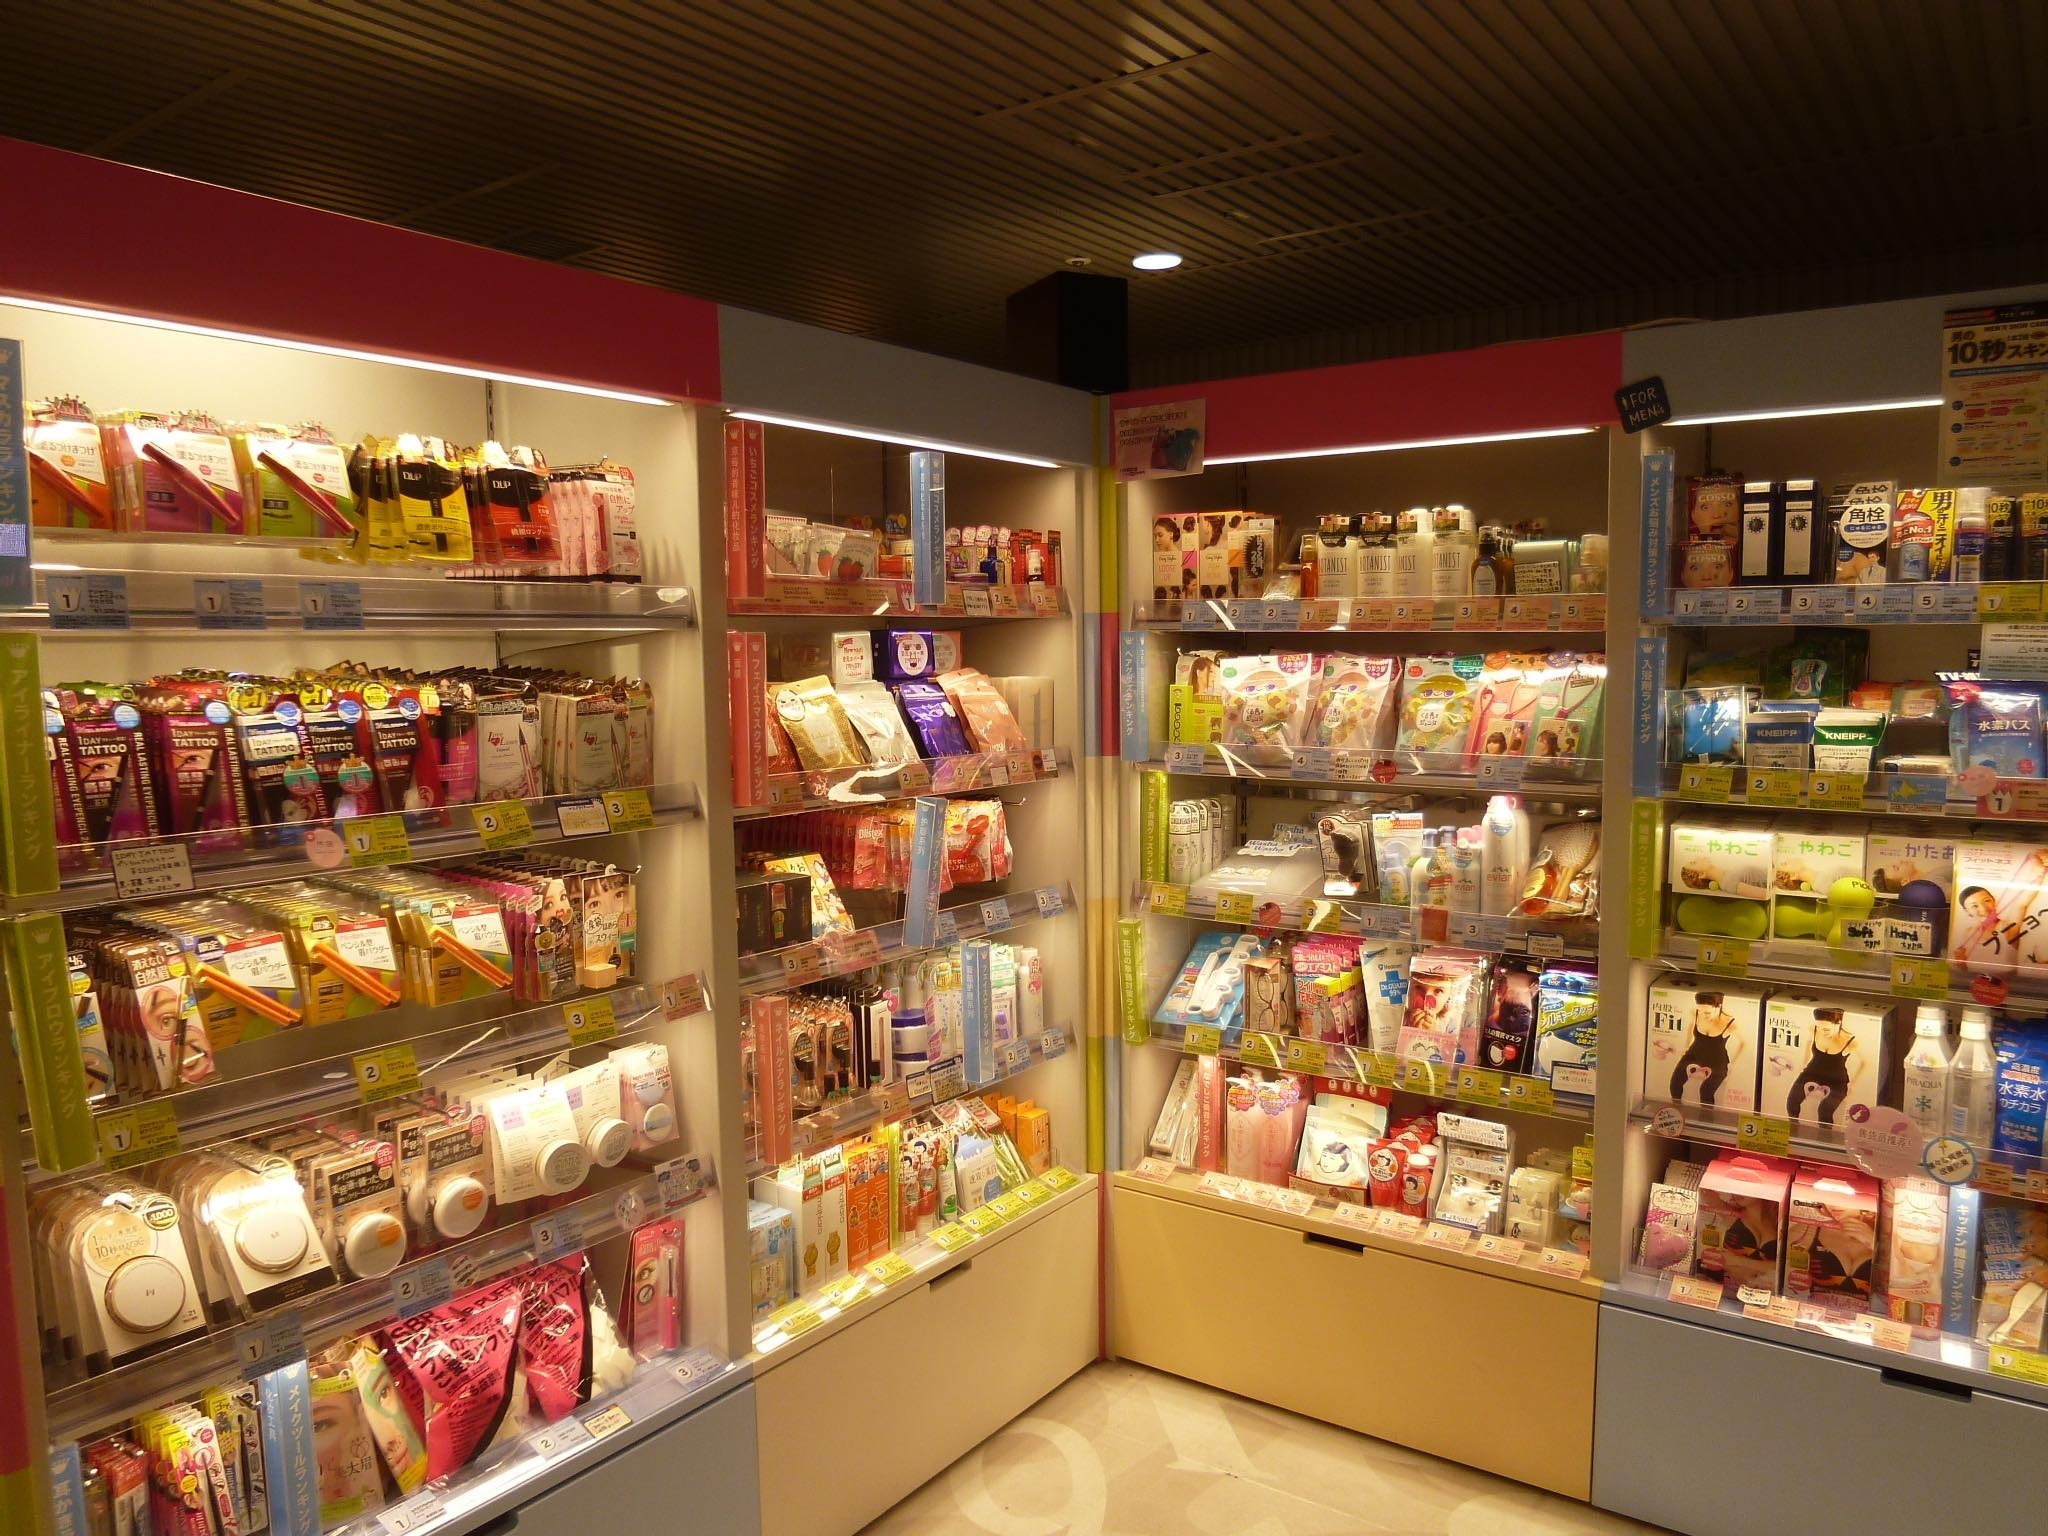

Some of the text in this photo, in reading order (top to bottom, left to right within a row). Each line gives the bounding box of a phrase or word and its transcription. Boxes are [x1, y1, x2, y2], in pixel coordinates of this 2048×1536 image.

[1951, 331, 1975, 343] 男の
[1630, 387, 1657, 407] FOR
[615, 504, 636, 515] アップ
[1848, 506, 1886, 524] 角栓
[1317, 557, 1348, 574] TANIST
[1397, 554, 1416, 572] NIST
[1432, 552, 1461, 571] TANIST
[171, 728, 193, 738] 1DAY
[751, 657, 764, 802] フェイスマスクランキング
[1756, 729, 1798, 737] KNEIPP
[1977, 719, 2031, 731] 水素バス
[78, 735, 101, 746] 1DAY
[134, 732, 144, 751] REAL
[173, 737, 218, 748] TATTOO
[223, 728, 234, 747] REAL
[378, 731, 397, 741] 1DAY
[380, 738, 417, 749] TATTOO
[1825, 732, 1867, 741] KNEIPP
[79, 743, 127, 756] TATTOO
[254, 744, 295, 756] TATTOO
[313, 743, 353, 754] TATTOO
[9, 669, 41, 860] アイライナーランキング
[858, 828, 883, 840] Blistex
[1249, 839, 1279, 847] Washa
[1706, 840, 1760, 857] やわこ
[1798, 840, 1852, 858] やわこ
[1847, 925, 1874, 939] Soft
[1890, 925, 1919, 942] Hard
[131, 954, 165, 970] 消えない
[1306, 961, 1339, 974] エアミスト
[135, 964, 169, 985] 自然眉
[1539, 1001, 1599, 1029] シルキータッチ
[1654, 1012, 1683, 1032] Fit
[1771, 1026, 1801, 1048] Fit
[773, 1021, 787, 1138] ネイルケアランキング
[1998, 1082, 2047, 1101] 水素水
[2000, 1098, 2041, 1114] のチカラ
[288, 1385, 314, 1530] メイクツールランキング
